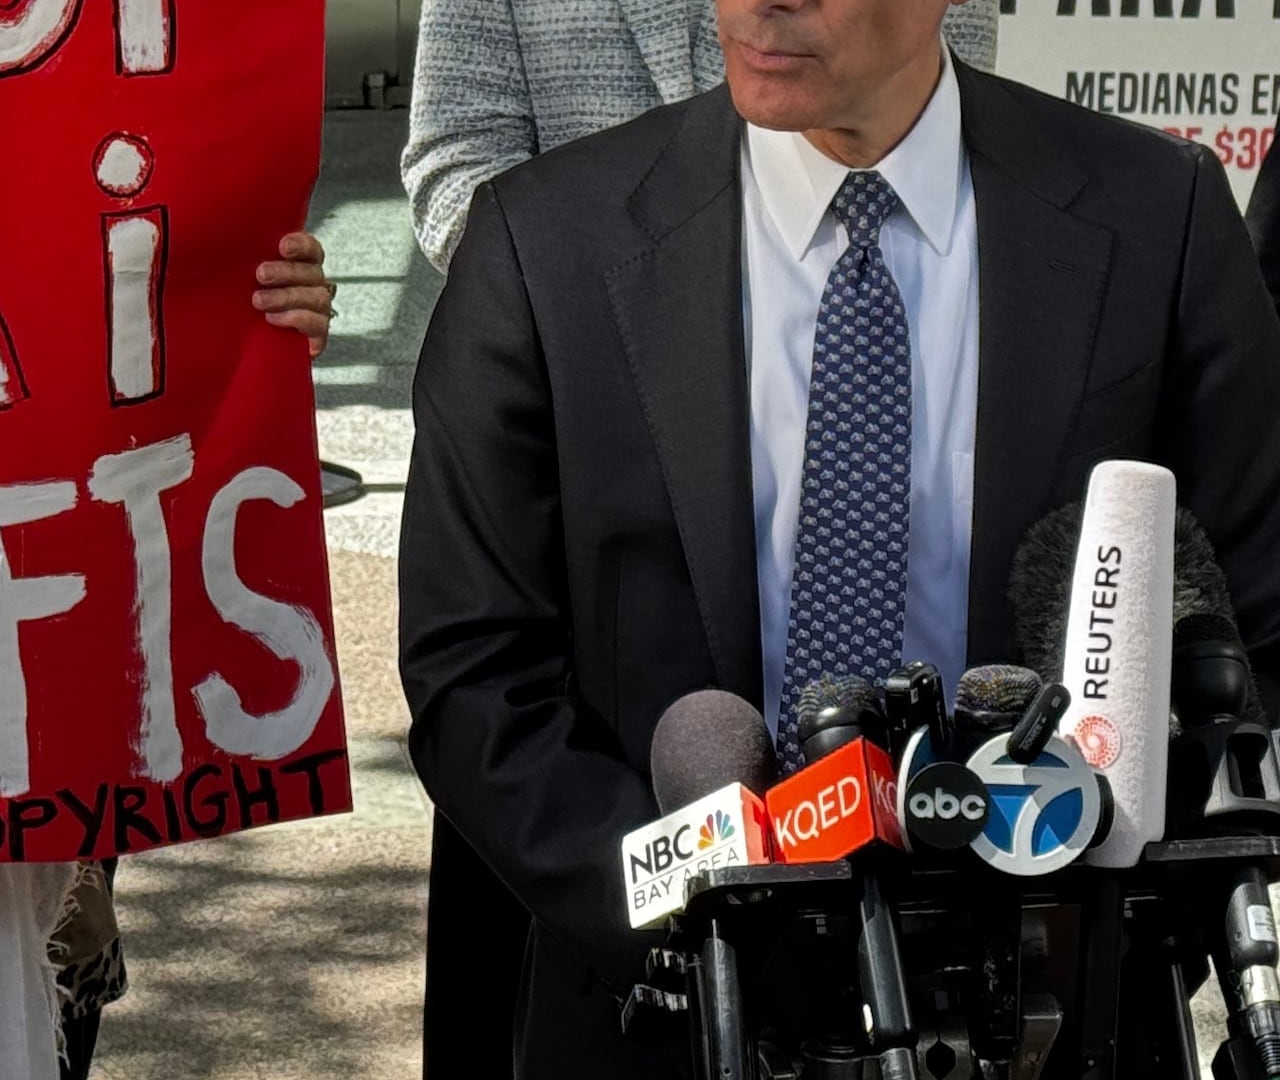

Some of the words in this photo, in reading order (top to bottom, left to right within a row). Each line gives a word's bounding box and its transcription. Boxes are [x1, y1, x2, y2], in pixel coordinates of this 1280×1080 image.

[1066, 71, 1239, 116] MEDIANAS
[1083, 545, 1122, 699] REUTERS
[775, 776, 861, 848] KQED
[909, 787, 986, 821] abc
[629, 824, 694, 884] NBC
[633, 874, 675, 910] BAY
